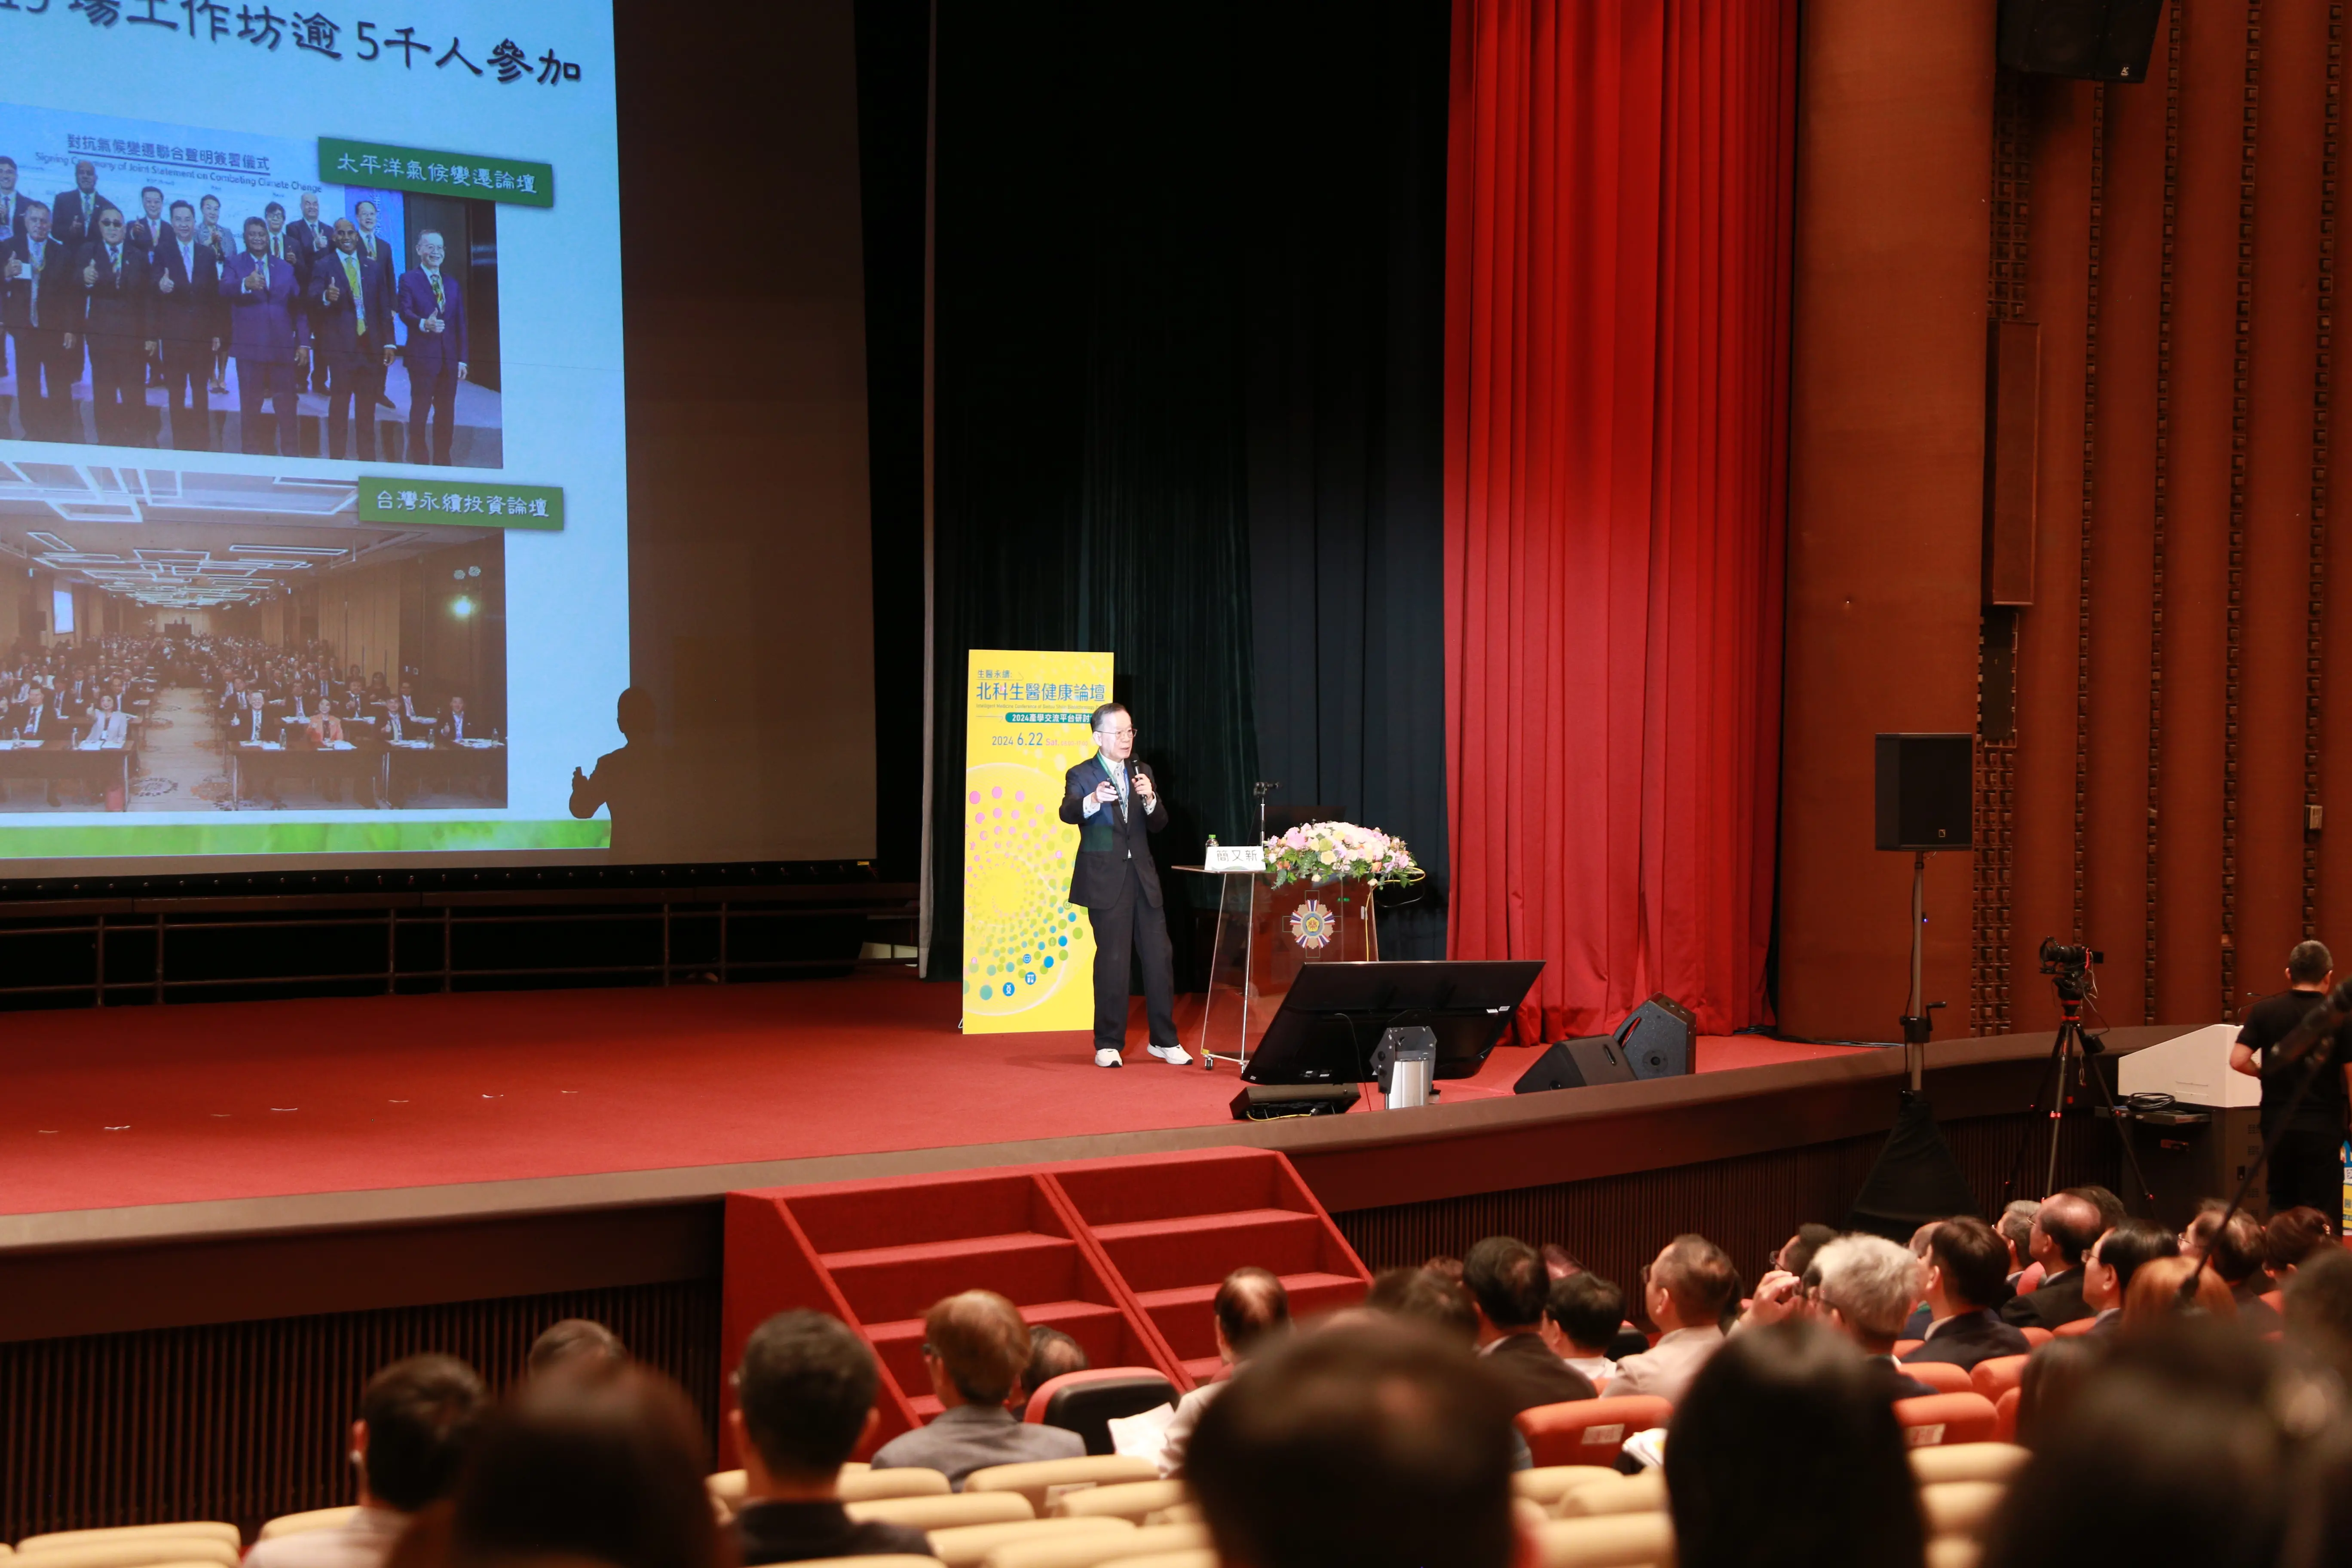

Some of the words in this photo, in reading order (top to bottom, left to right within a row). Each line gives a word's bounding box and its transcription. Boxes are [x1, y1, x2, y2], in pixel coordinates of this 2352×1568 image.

[119, 162, 126, 170] of
[129, 162, 149, 173] Joint
[152, 165, 194, 178] Statement
[291, 181, 322, 193] Change
[337, 153, 537, 194] 太平洋氣候變遷論壇
[377, 490, 549, 517] 台灣永續投資論壇
[976, 682, 1106, 701] 北科生醫健康論壇
[1012, 714, 1092, 723] 2024產學交流平台研討
[992, 736, 1013, 745] 2024
[1017, 732, 1043, 745] 6.22
[1216, 849, 1257, 862] 簡又新
